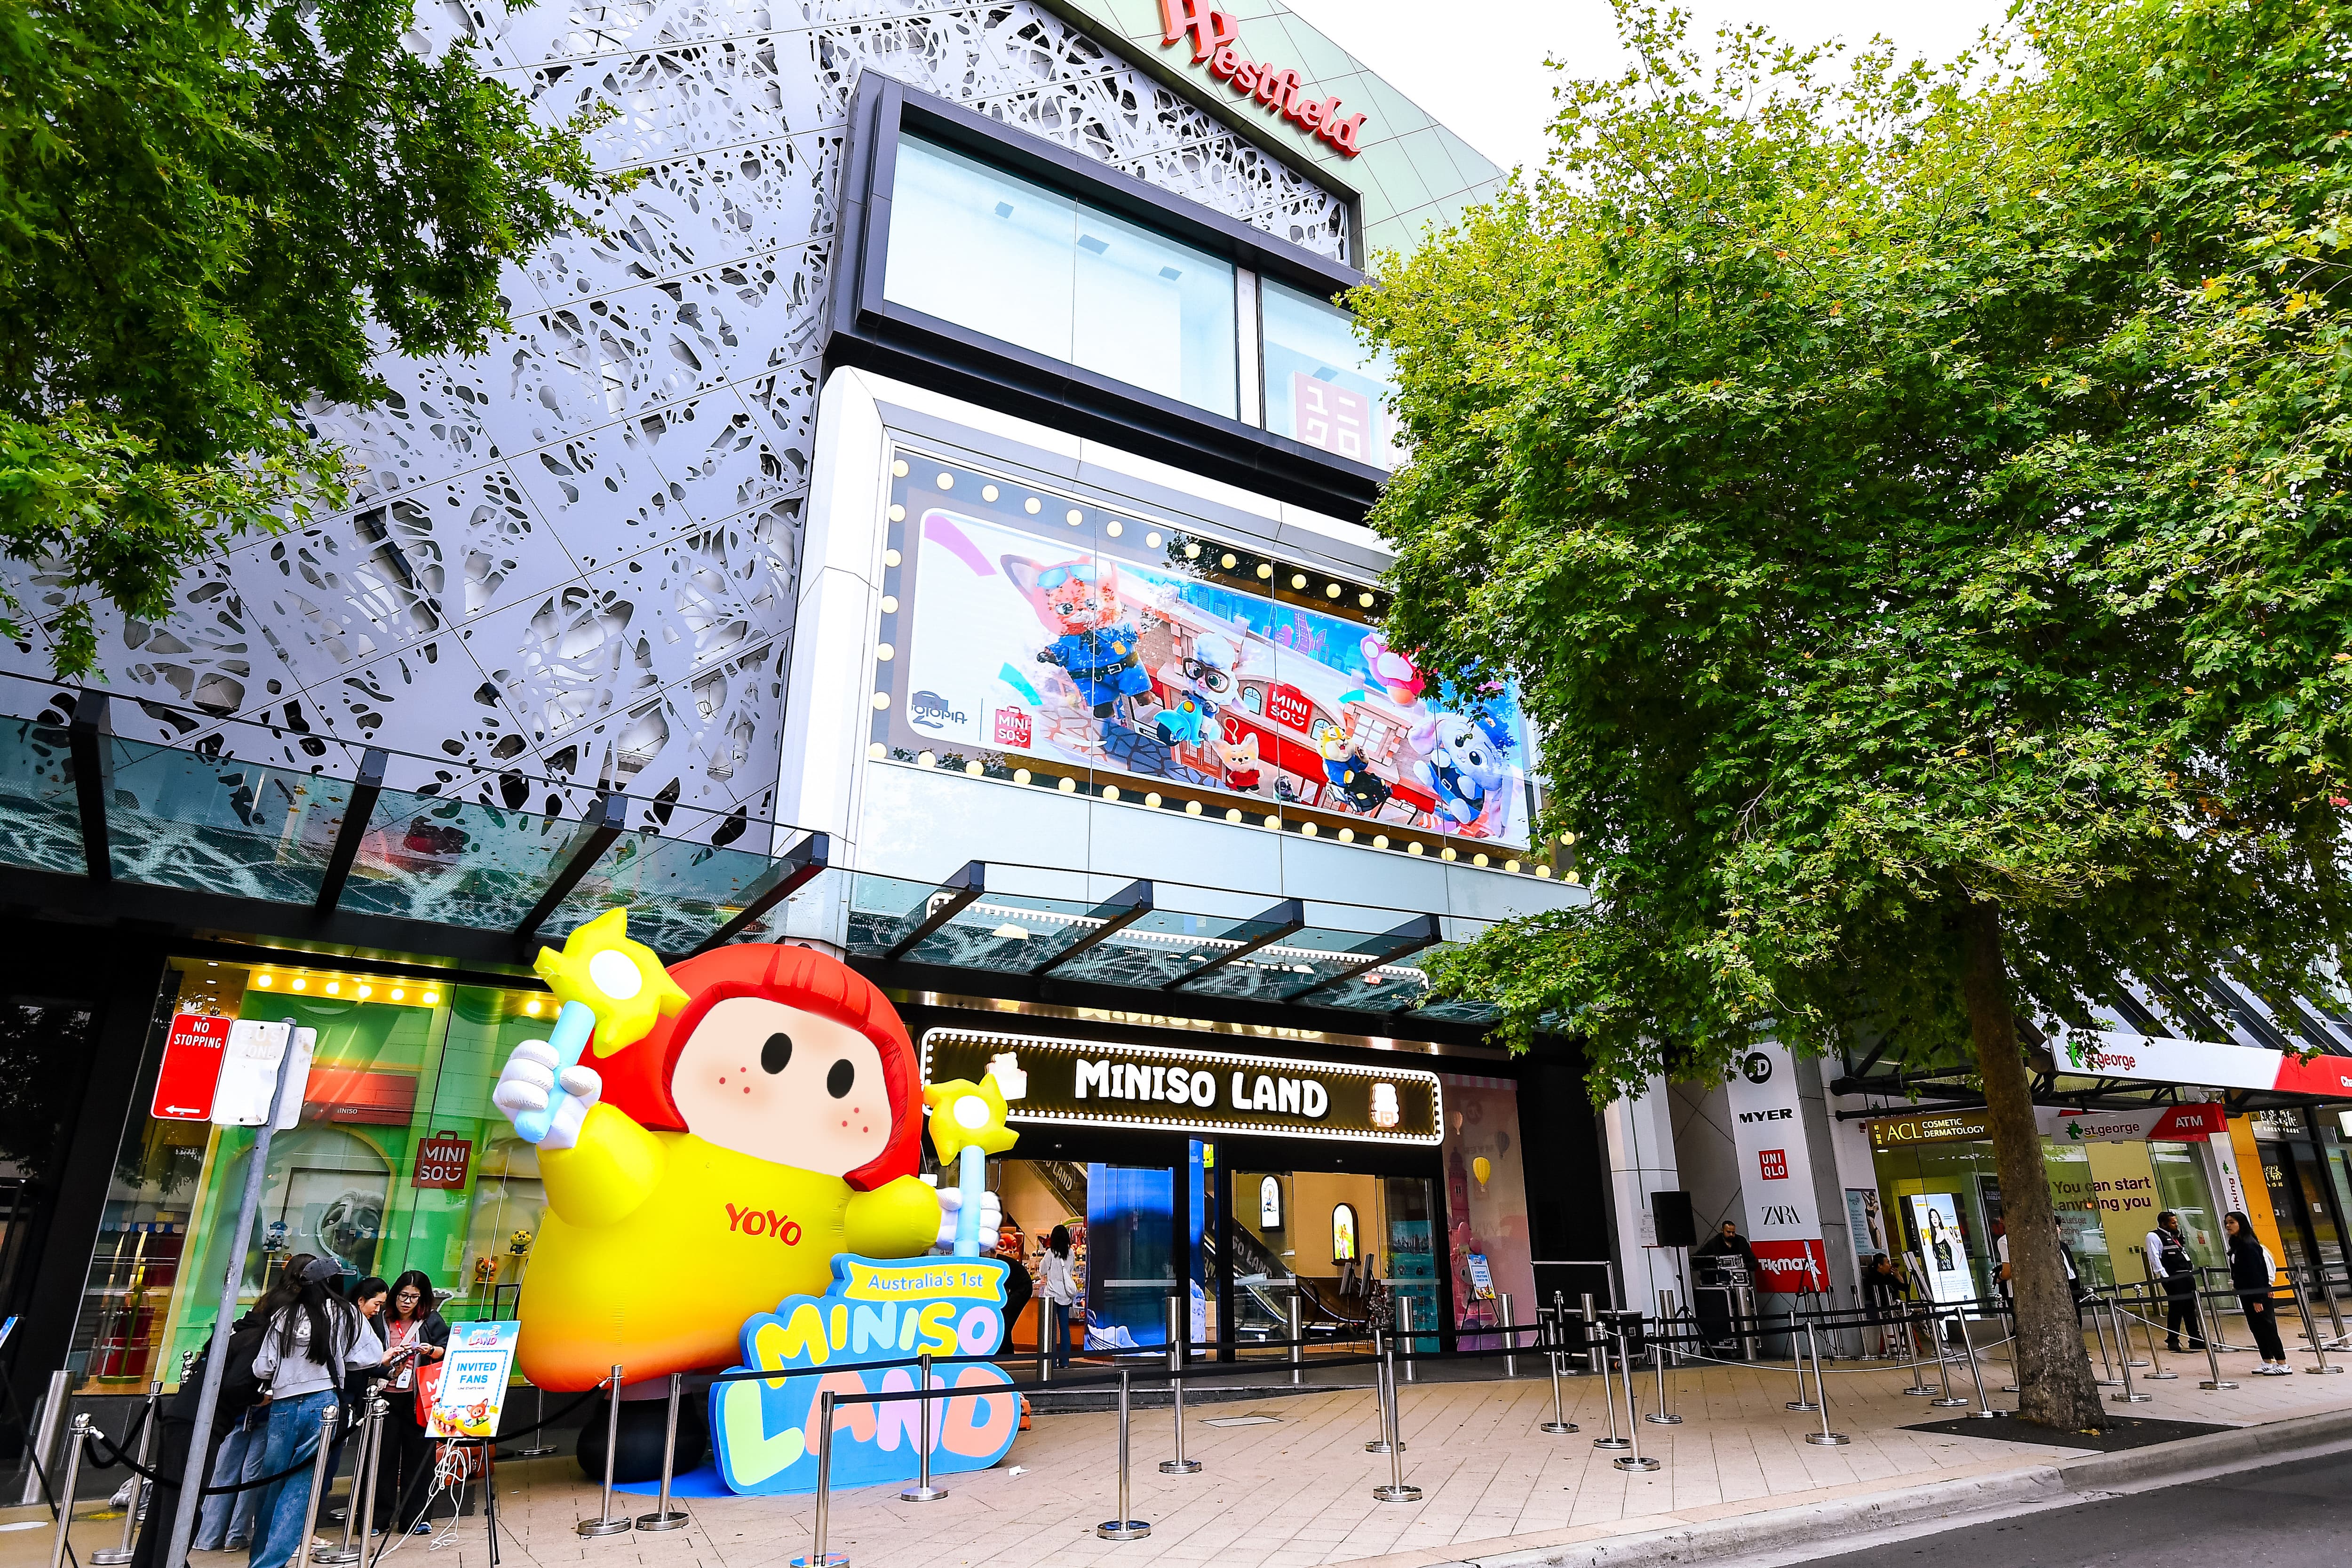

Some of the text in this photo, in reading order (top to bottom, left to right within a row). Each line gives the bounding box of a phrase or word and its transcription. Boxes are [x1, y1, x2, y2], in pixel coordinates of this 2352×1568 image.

[1161, 0, 1367, 157] Westfield
[1271, 691, 1308, 716] MINI
[912, 704, 968, 724] OTOPIA
[998, 714, 1028, 730] MINI
[1143, 729, 1160, 740] MINIS
[192, 1021, 210, 1033] NO
[173, 1033, 222, 1049] STOPPING
[1074, 1059, 1328, 1118] MINISO LAND
[1739, 1108, 1793, 1124] MYER
[1922, 1118, 1963, 1129] COSMETIC
[2176, 1115, 2203, 1128] ATM
[1887, 1123, 1922, 1141] ACL
[1924, 1125, 1985, 1138] DERMATOLOGY
[2084, 1123, 2140, 1137] st.george
[425, 1146, 466, 1162] MINI
[1762, 1153, 1781, 1164] UNI
[1053, 1161, 1073, 1191] LAND
[1764, 1165, 1785, 1178] QLO
[2052, 1176, 2152, 1194] You can start
[2229, 1178, 2241, 1210] nking
[2058, 1196, 2152, 1212] anything you
[1761, 1204, 1801, 1225] ZARA
[725, 1202, 802, 1247] YOYO
[867, 1271, 984, 1291] Australia's 1st
[755, 1301, 999, 1390] MINISO
[457, 1362, 497, 1371] INVITED
[460, 1375, 488, 1383] FANS
[724, 1367, 1014, 1487] LAND
